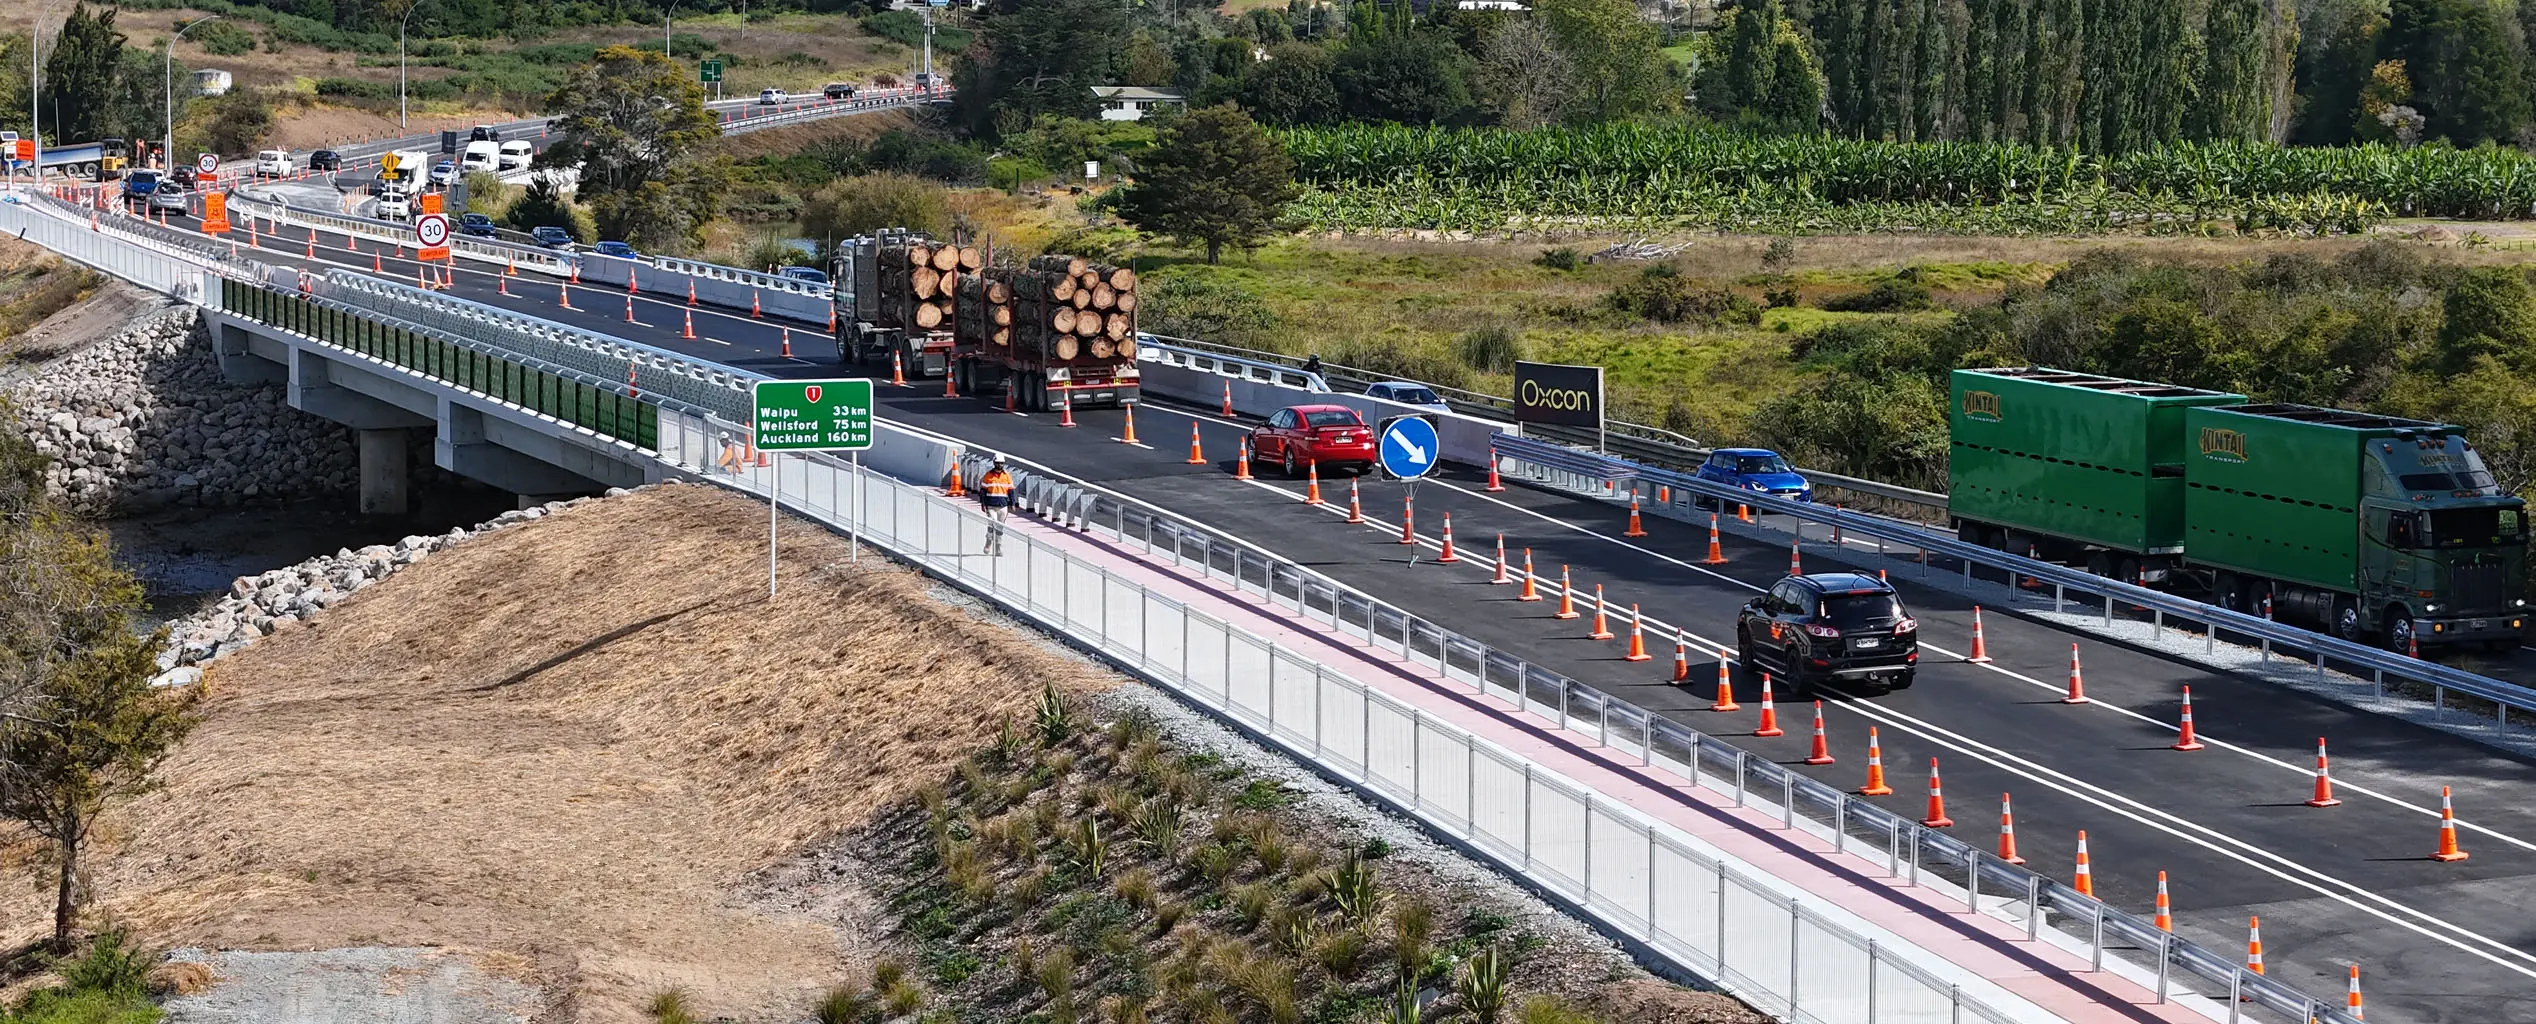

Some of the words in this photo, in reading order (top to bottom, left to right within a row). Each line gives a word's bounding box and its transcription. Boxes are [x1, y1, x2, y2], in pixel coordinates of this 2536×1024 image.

[203, 159, 214, 168] 30
[424, 224, 442, 237] 30
[811, 388, 816, 398] 1
[1521, 379, 1591, 412] Oxcon
[1962, 390, 2003, 419] KINTAIL
[760, 407, 798, 419] Waipu
[833, 405, 849, 416] 33
[851, 406, 867, 416] km
[760, 420, 818, 431] Wellsford
[833, 419, 849, 429] 75
[851, 420, 867, 430] km
[1967, 415, 2001, 423] TRANSPORT
[760, 433, 819, 444] Auckland
[827, 432, 849, 443] 160
[851, 433, 867, 442] km
[2199, 427, 2249, 461] KINTAIL
[2205, 455, 2246, 464] TRANSPORT
